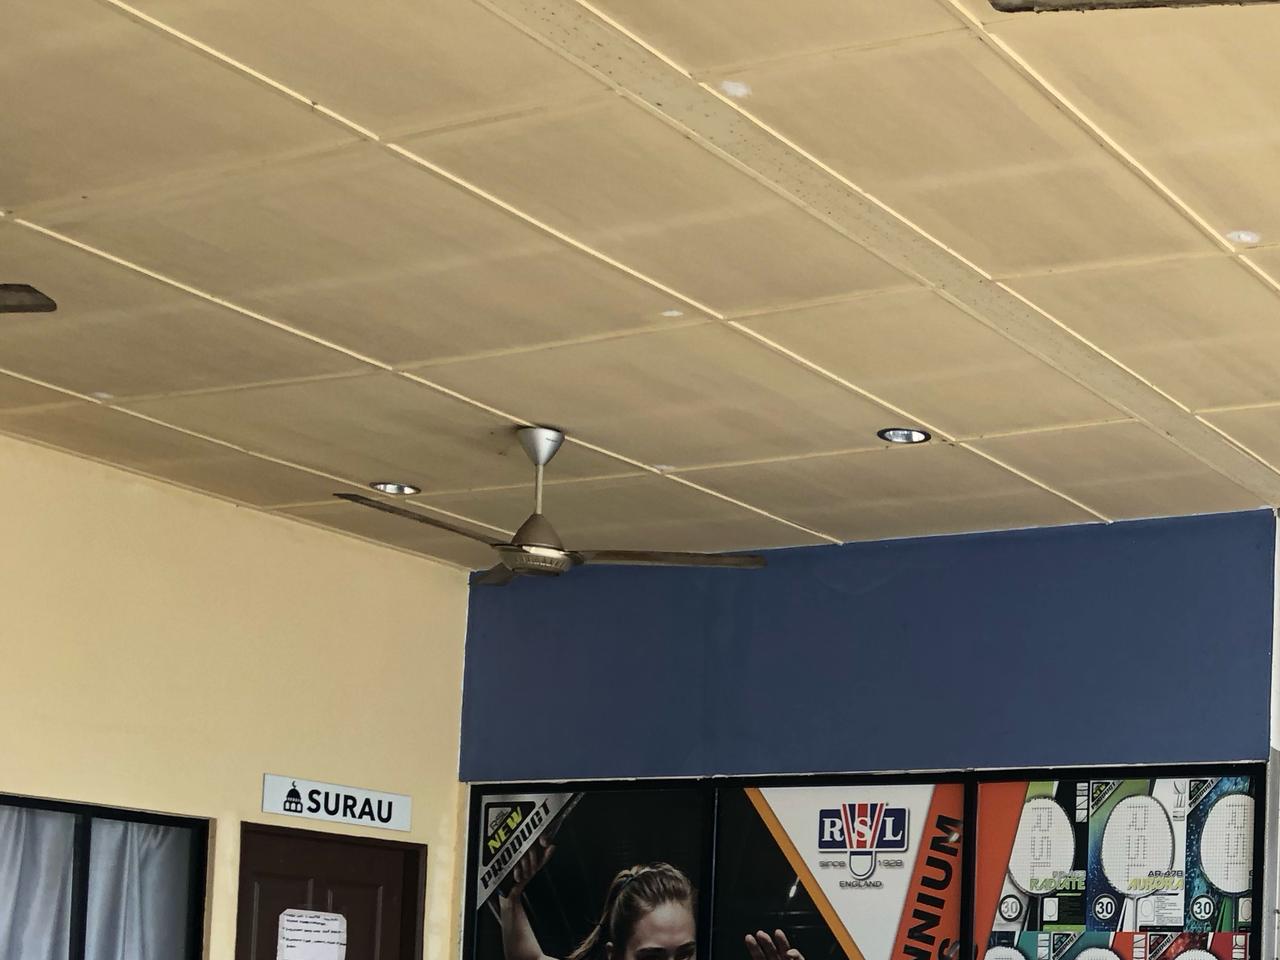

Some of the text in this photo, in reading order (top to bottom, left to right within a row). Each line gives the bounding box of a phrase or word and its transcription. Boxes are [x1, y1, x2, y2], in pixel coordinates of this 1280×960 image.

[306, 788, 393, 823] SURAU
[487, 805, 523, 854] NEW
[821, 816, 903, 842] RSL
[480, 798, 550, 889] PRODUCT
[878, 859, 903, 867] 1928
[839, 880, 883, 888] ENGLAND
[1002, 901, 1019, 915] 30
[1096, 902, 1113, 915] 30
[1194, 901, 1211, 915] 30
